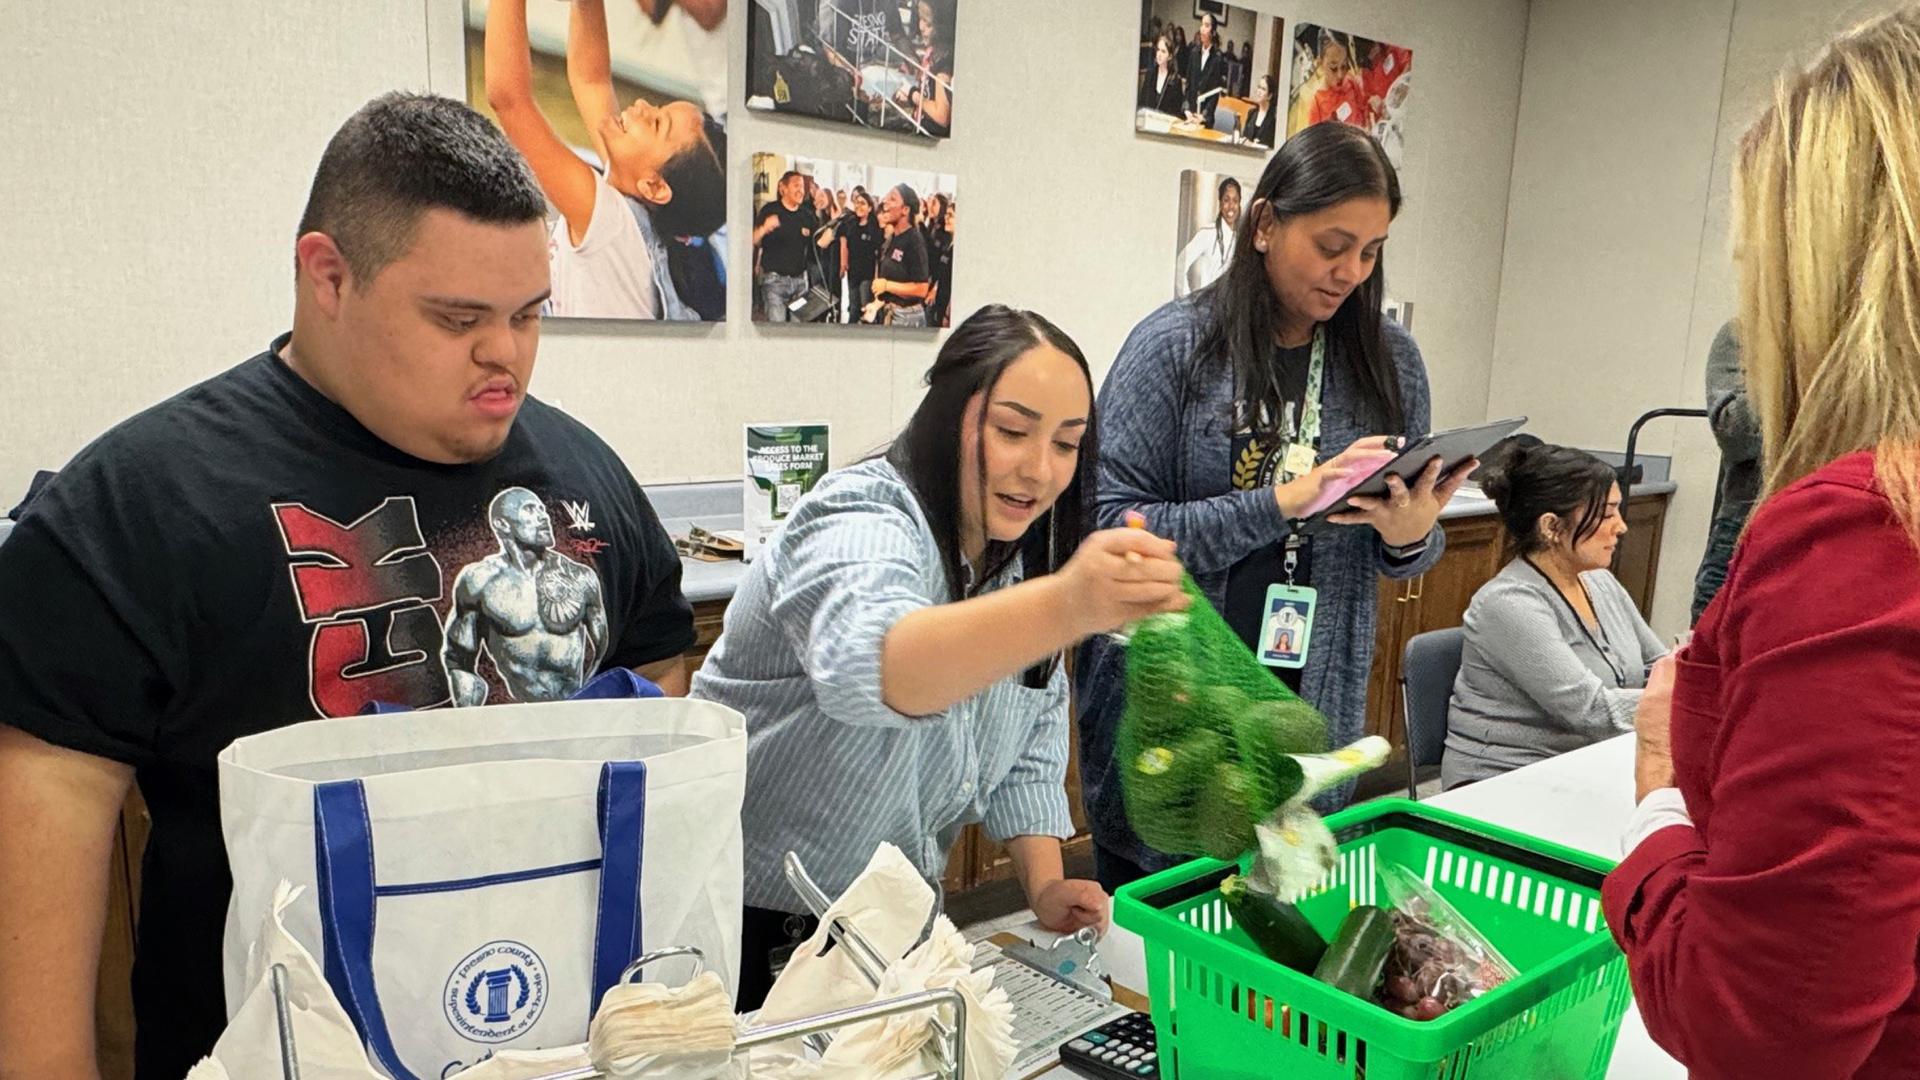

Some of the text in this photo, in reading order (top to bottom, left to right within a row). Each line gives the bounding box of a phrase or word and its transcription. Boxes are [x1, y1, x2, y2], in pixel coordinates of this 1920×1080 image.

[759, 444, 818, 454] ACCESS TO THE
[752, 453, 824, 463] PRODUCE MARKET
[790, 462, 813, 470] FORM
